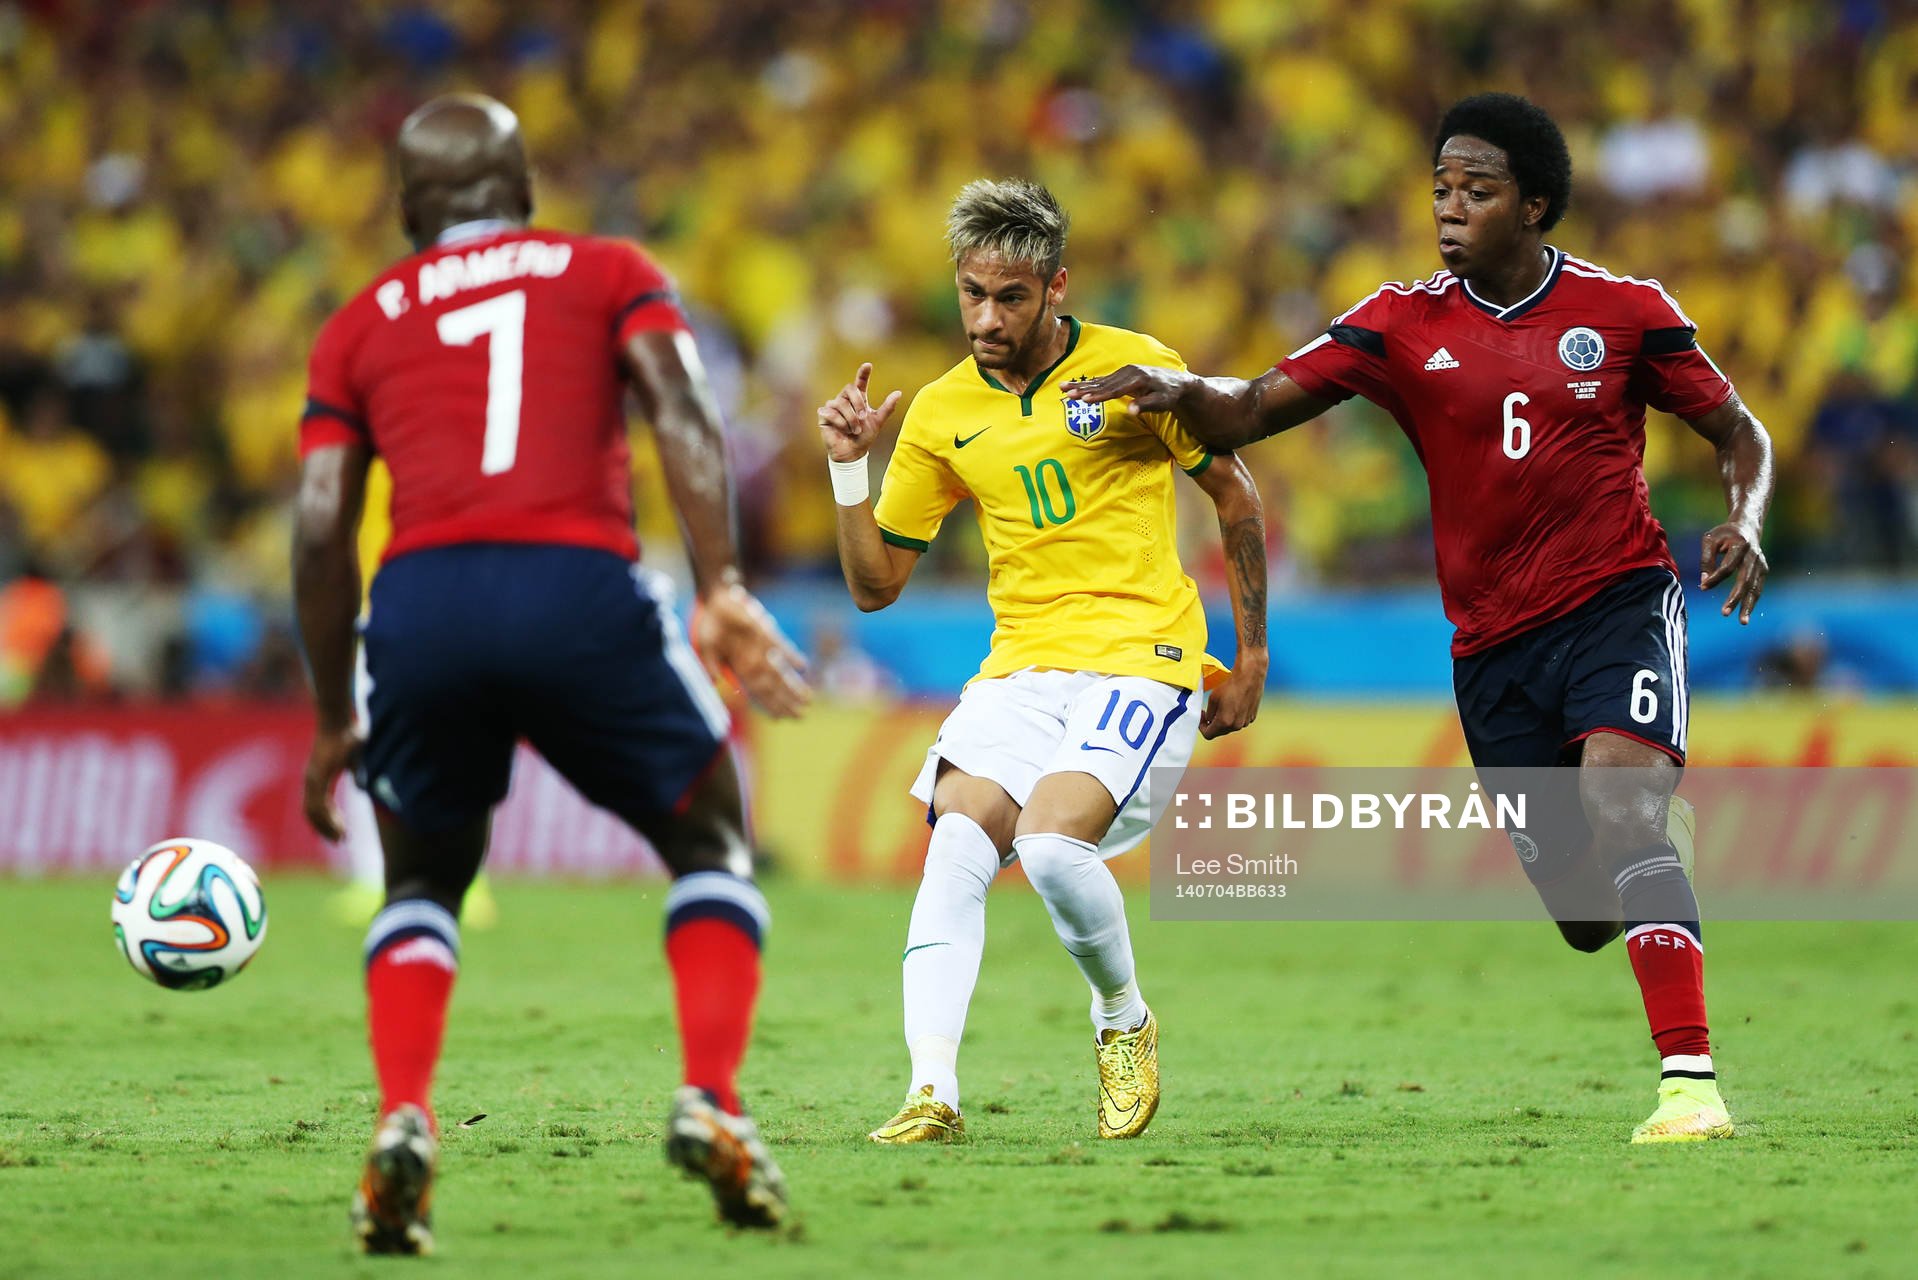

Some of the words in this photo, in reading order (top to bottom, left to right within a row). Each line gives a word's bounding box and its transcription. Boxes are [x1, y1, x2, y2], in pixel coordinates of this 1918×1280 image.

[436, 289, 526, 476] 7
[1424, 360, 1460, 371] adidas
[1076, 407, 1092, 415] CBF
[1502, 391, 1531, 460] 6
[1013, 458, 1077, 529] 10
[1096, 689, 1155, 751] 10
[1629, 669, 1660, 724] 6
[1639, 934, 1686, 950] FCF
